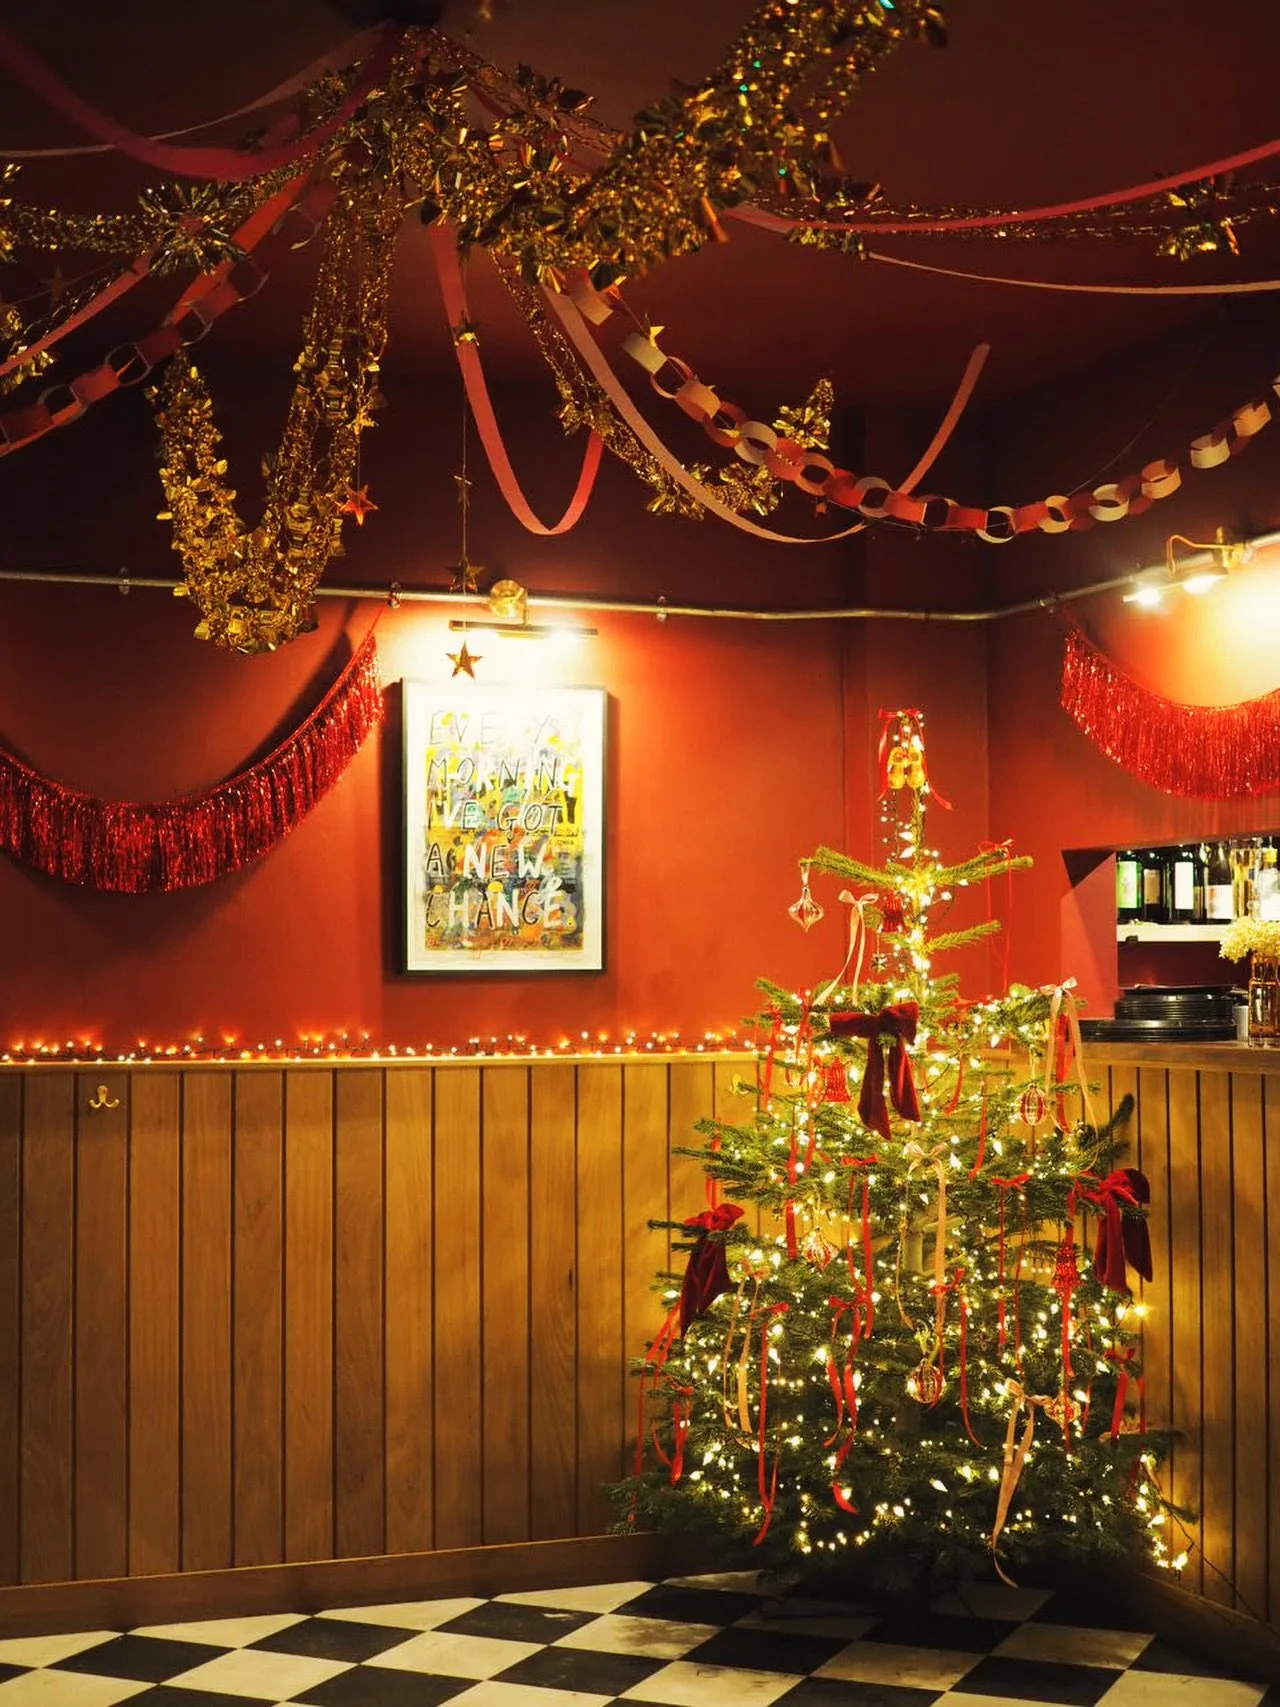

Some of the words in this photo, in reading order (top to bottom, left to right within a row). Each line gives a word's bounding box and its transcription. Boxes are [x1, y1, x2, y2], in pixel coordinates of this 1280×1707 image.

[429, 709, 553, 745] EVEY
[496, 800, 564, 834] GOT
[426, 842, 444, 877] A
[463, 839, 547, 879] NEW
